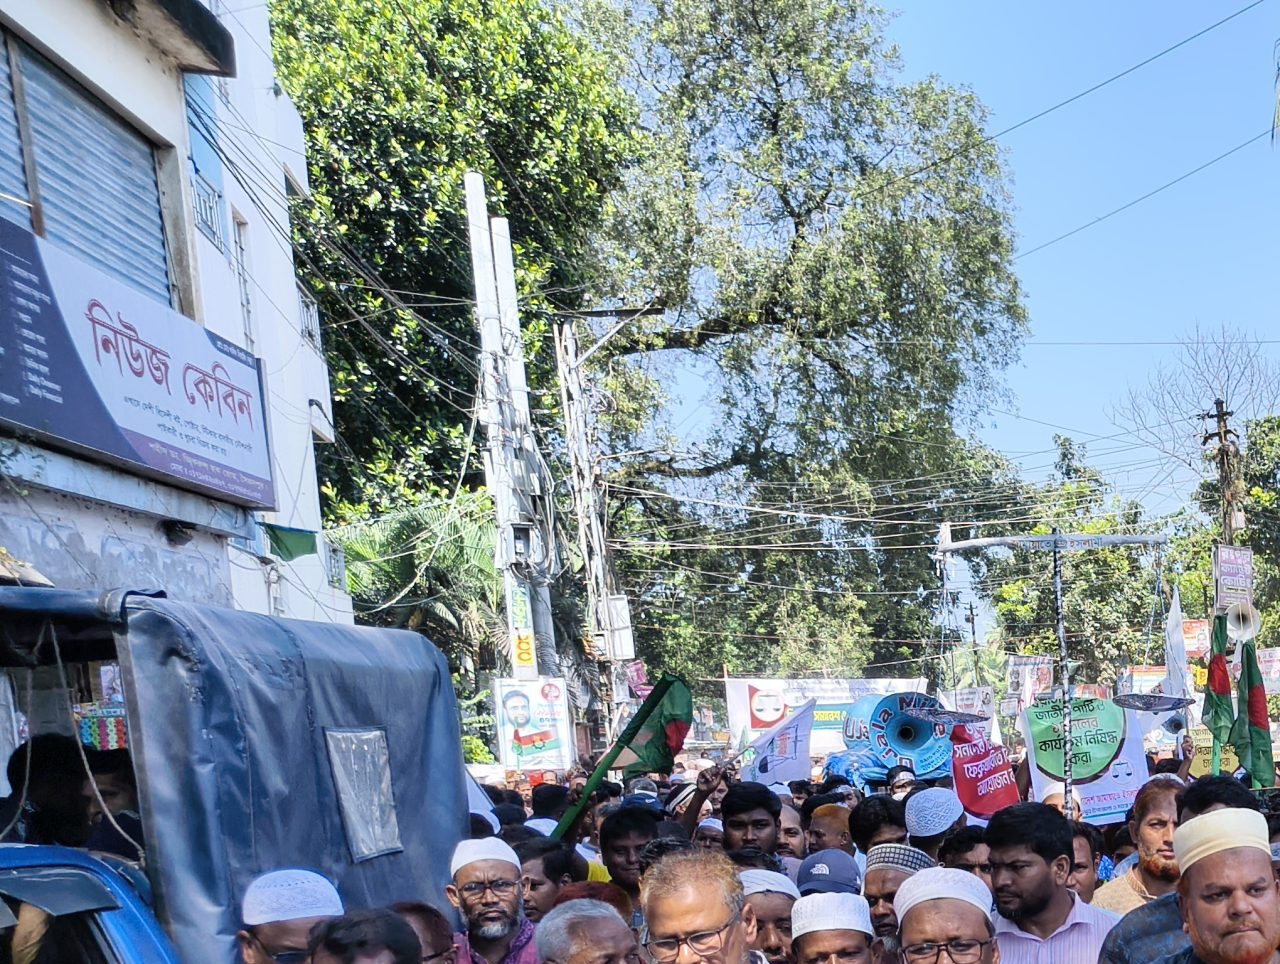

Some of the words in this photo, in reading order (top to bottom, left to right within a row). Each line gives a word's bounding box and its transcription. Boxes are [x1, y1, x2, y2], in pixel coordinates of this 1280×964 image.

[86, 299, 172, 396] নিউজ
[182, 360, 254, 432] কেবিন
[1034, 704, 1065, 720] জাতী
[1038, 733, 1084, 753] কার্যম
